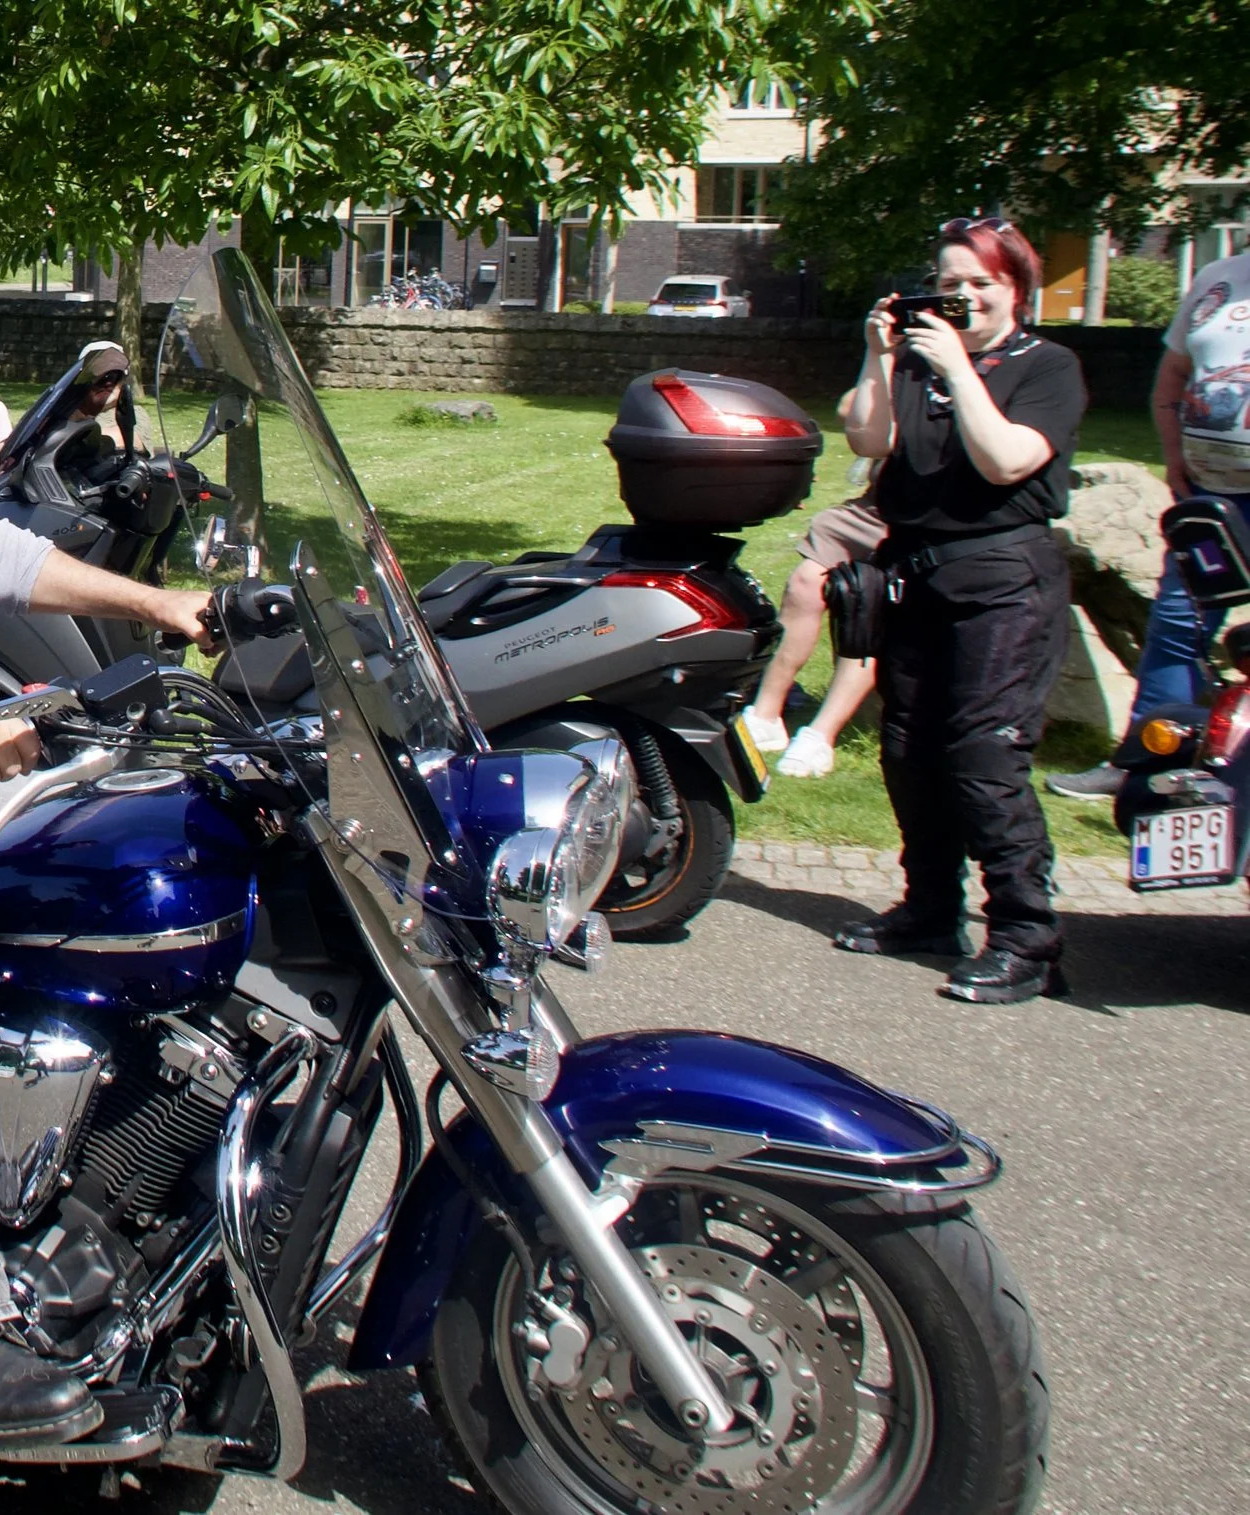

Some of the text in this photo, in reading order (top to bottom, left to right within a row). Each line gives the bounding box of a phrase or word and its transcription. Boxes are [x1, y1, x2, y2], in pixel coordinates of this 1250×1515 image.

[1192, 548, 1223, 571] L
[494, 616, 609, 664] METROPOLIS
[504, 626, 556, 649] PEUGEOT
[1172, 812, 1222, 841] BPG
[1171, 843, 1219, 871] 951
